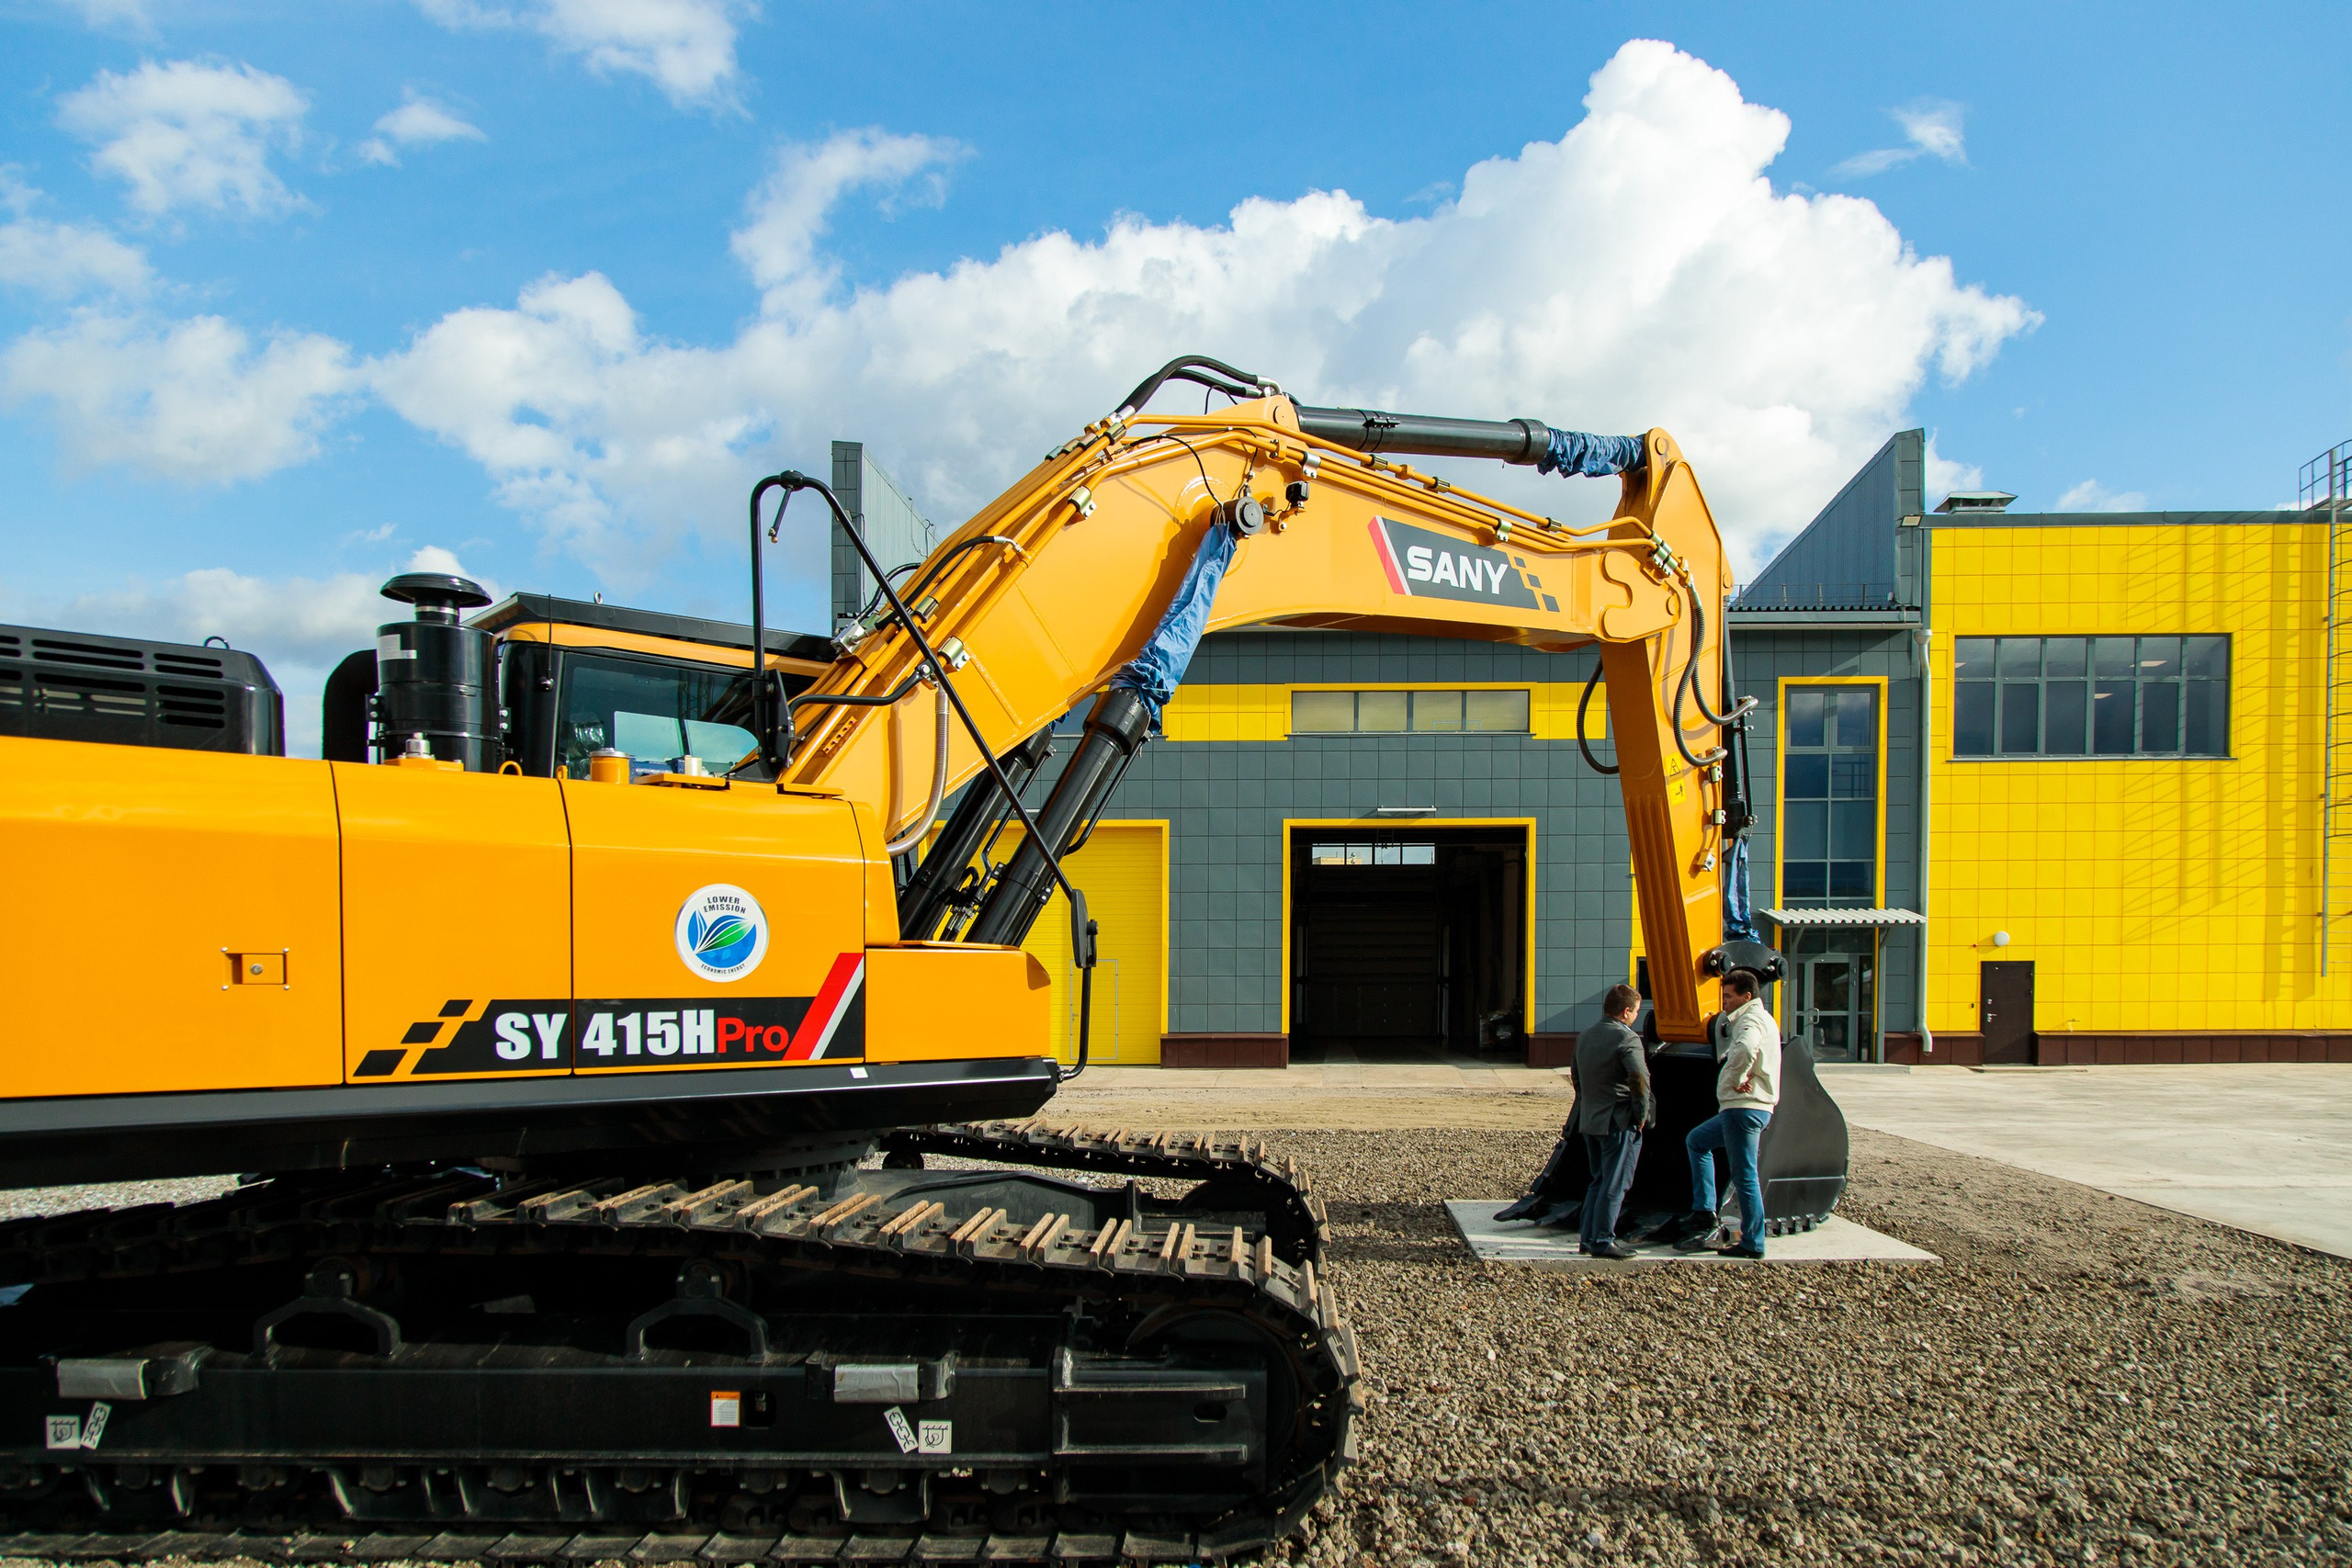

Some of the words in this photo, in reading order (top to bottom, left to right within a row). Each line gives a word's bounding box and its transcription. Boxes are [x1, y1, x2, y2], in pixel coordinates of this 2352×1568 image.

[1407, 545, 1509, 595] SANY
[707, 896, 741, 905] LOWER
[703, 903, 747, 914] EMISSION
[701, 964, 727, 975] ECONOMIC
[728, 963, 746, 974] ENERGY
[494, 1012, 568, 1060] SY
